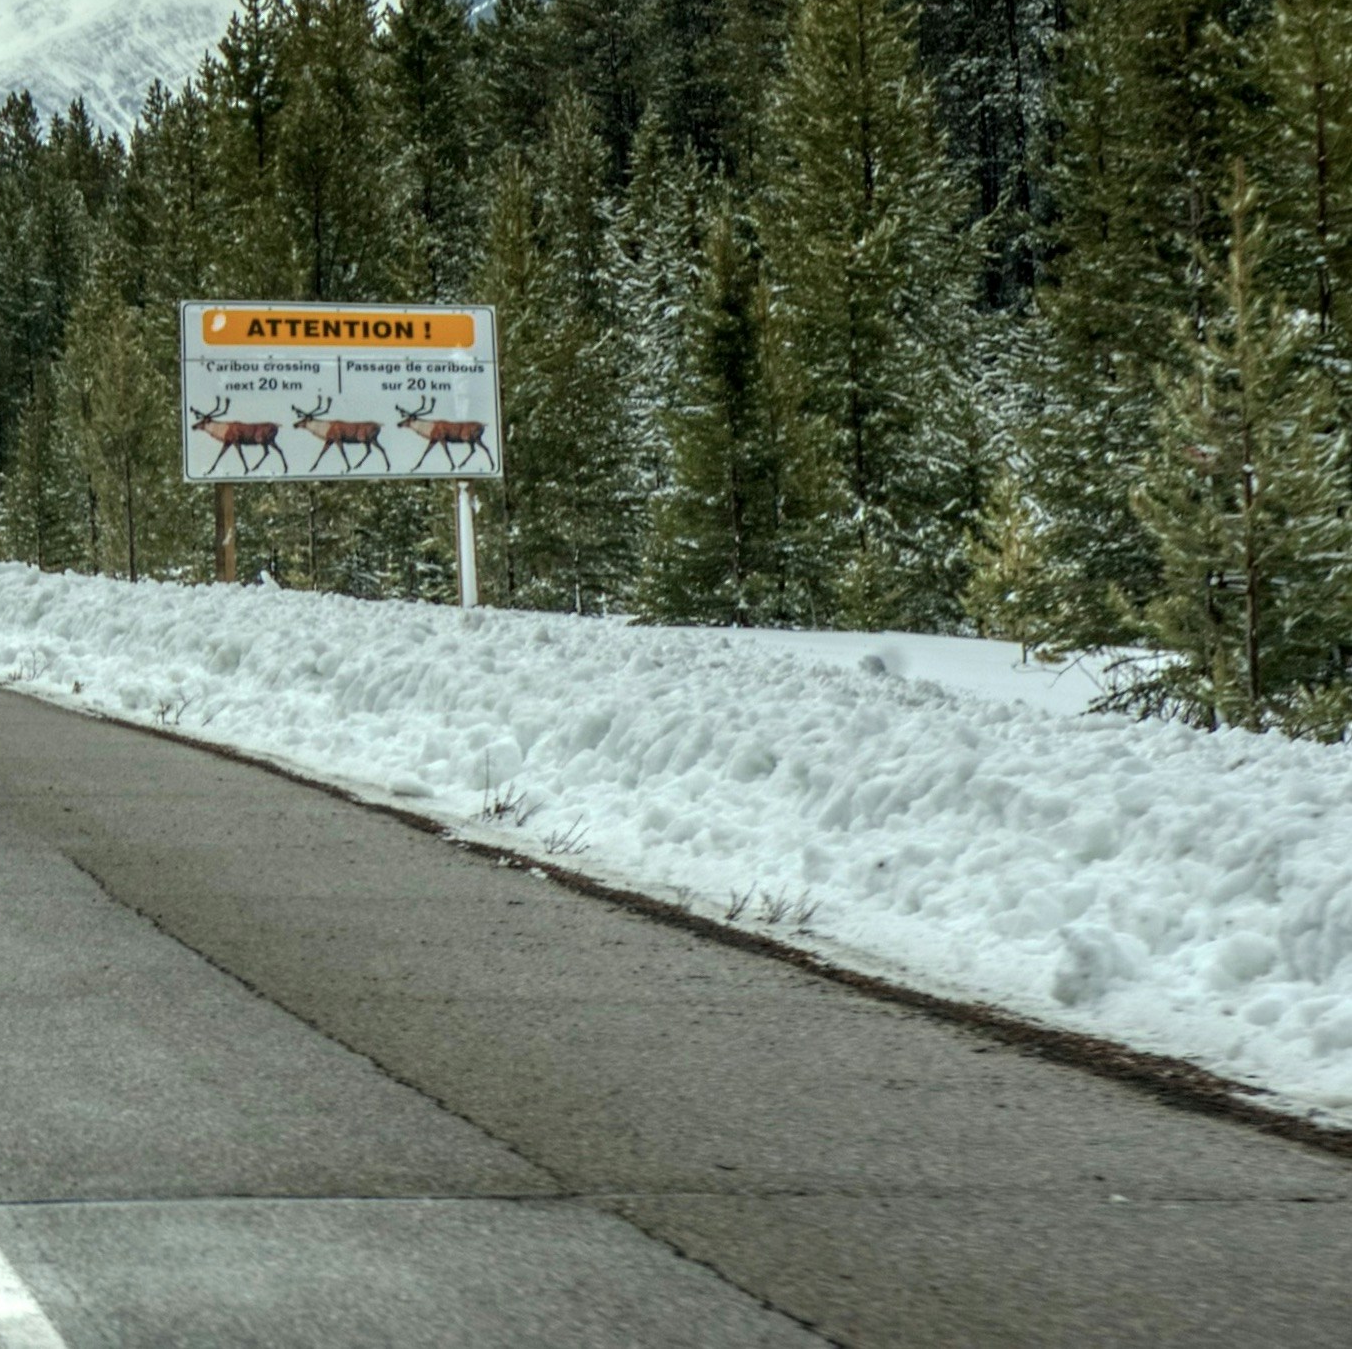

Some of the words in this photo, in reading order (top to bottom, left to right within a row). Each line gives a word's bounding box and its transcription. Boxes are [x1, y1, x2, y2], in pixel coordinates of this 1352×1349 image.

[247, 318, 414, 339] ATTENTION
[424, 322, 432, 339] !
[206, 360, 259, 372] Caribou
[263, 360, 320, 373] crossing
[346, 360, 401, 373] Passage
[406, 361, 422, 372] de
[426, 360, 485, 372] caribous
[225, 380, 254, 391] next
[258, 377, 278, 391] 20
[282, 380, 302, 391] km
[382, 382, 403, 391] sur
[406, 378, 426, 391] 20
[430, 380, 451, 391] km
